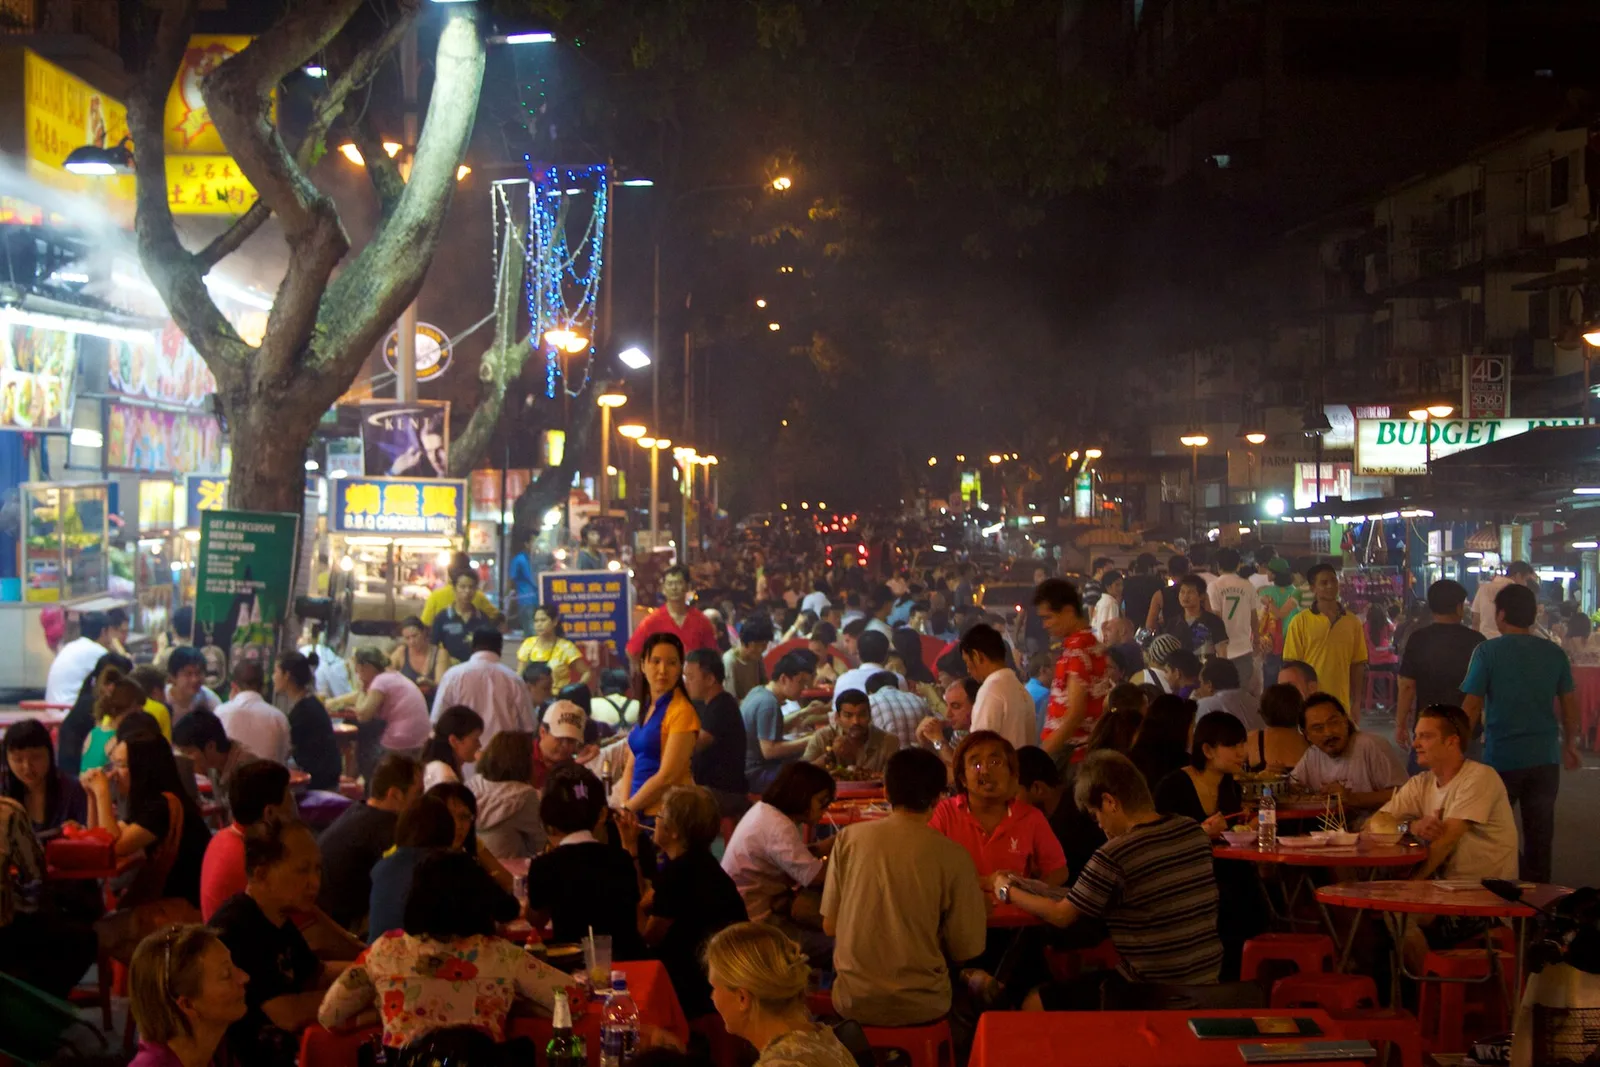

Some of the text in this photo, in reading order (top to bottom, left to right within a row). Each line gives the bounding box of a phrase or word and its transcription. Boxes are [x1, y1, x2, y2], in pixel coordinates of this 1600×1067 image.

[1471, 358, 1504, 381] 4D
[384, 417, 431, 431] KENT
[1375, 421, 1501, 445] BUDGET
[376, 515, 426, 531] CHICKEN
[1226, 596, 1240, 620] 7
